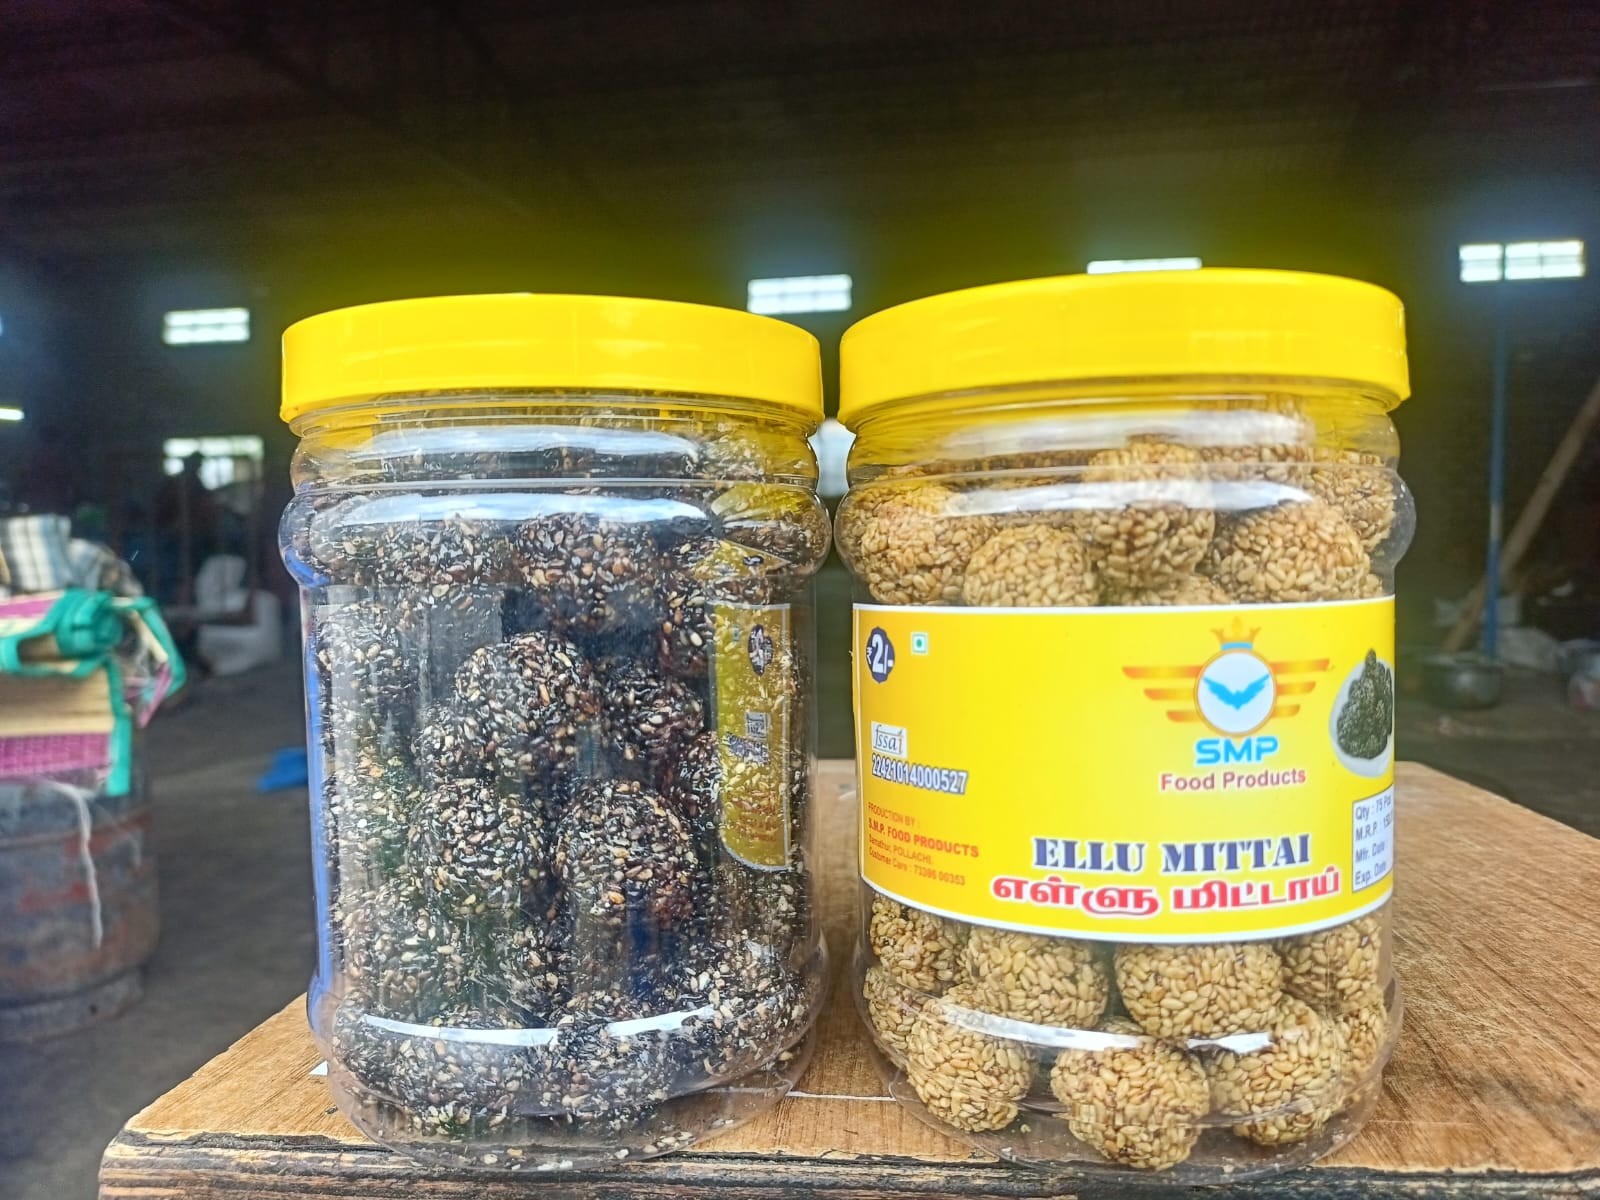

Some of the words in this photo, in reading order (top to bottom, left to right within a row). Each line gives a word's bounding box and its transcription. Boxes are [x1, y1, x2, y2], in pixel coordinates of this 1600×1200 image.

[1195, 736, 1278, 764] SMP
[872, 753, 968, 795] 22421014000527
[1160, 772, 1216, 791] Food
[1222, 767, 1307, 789] Products
[887, 826, 911, 844] FOOD
[913, 834, 980, 859] PRODUCTS
[1033, 837, 1145, 873] ELLU
[1163, 833, 1311, 872] MITTAI
[992, 875, 1159, 916] எள்ளு
[1173, 865, 1341, 910] மிட்டாய்
